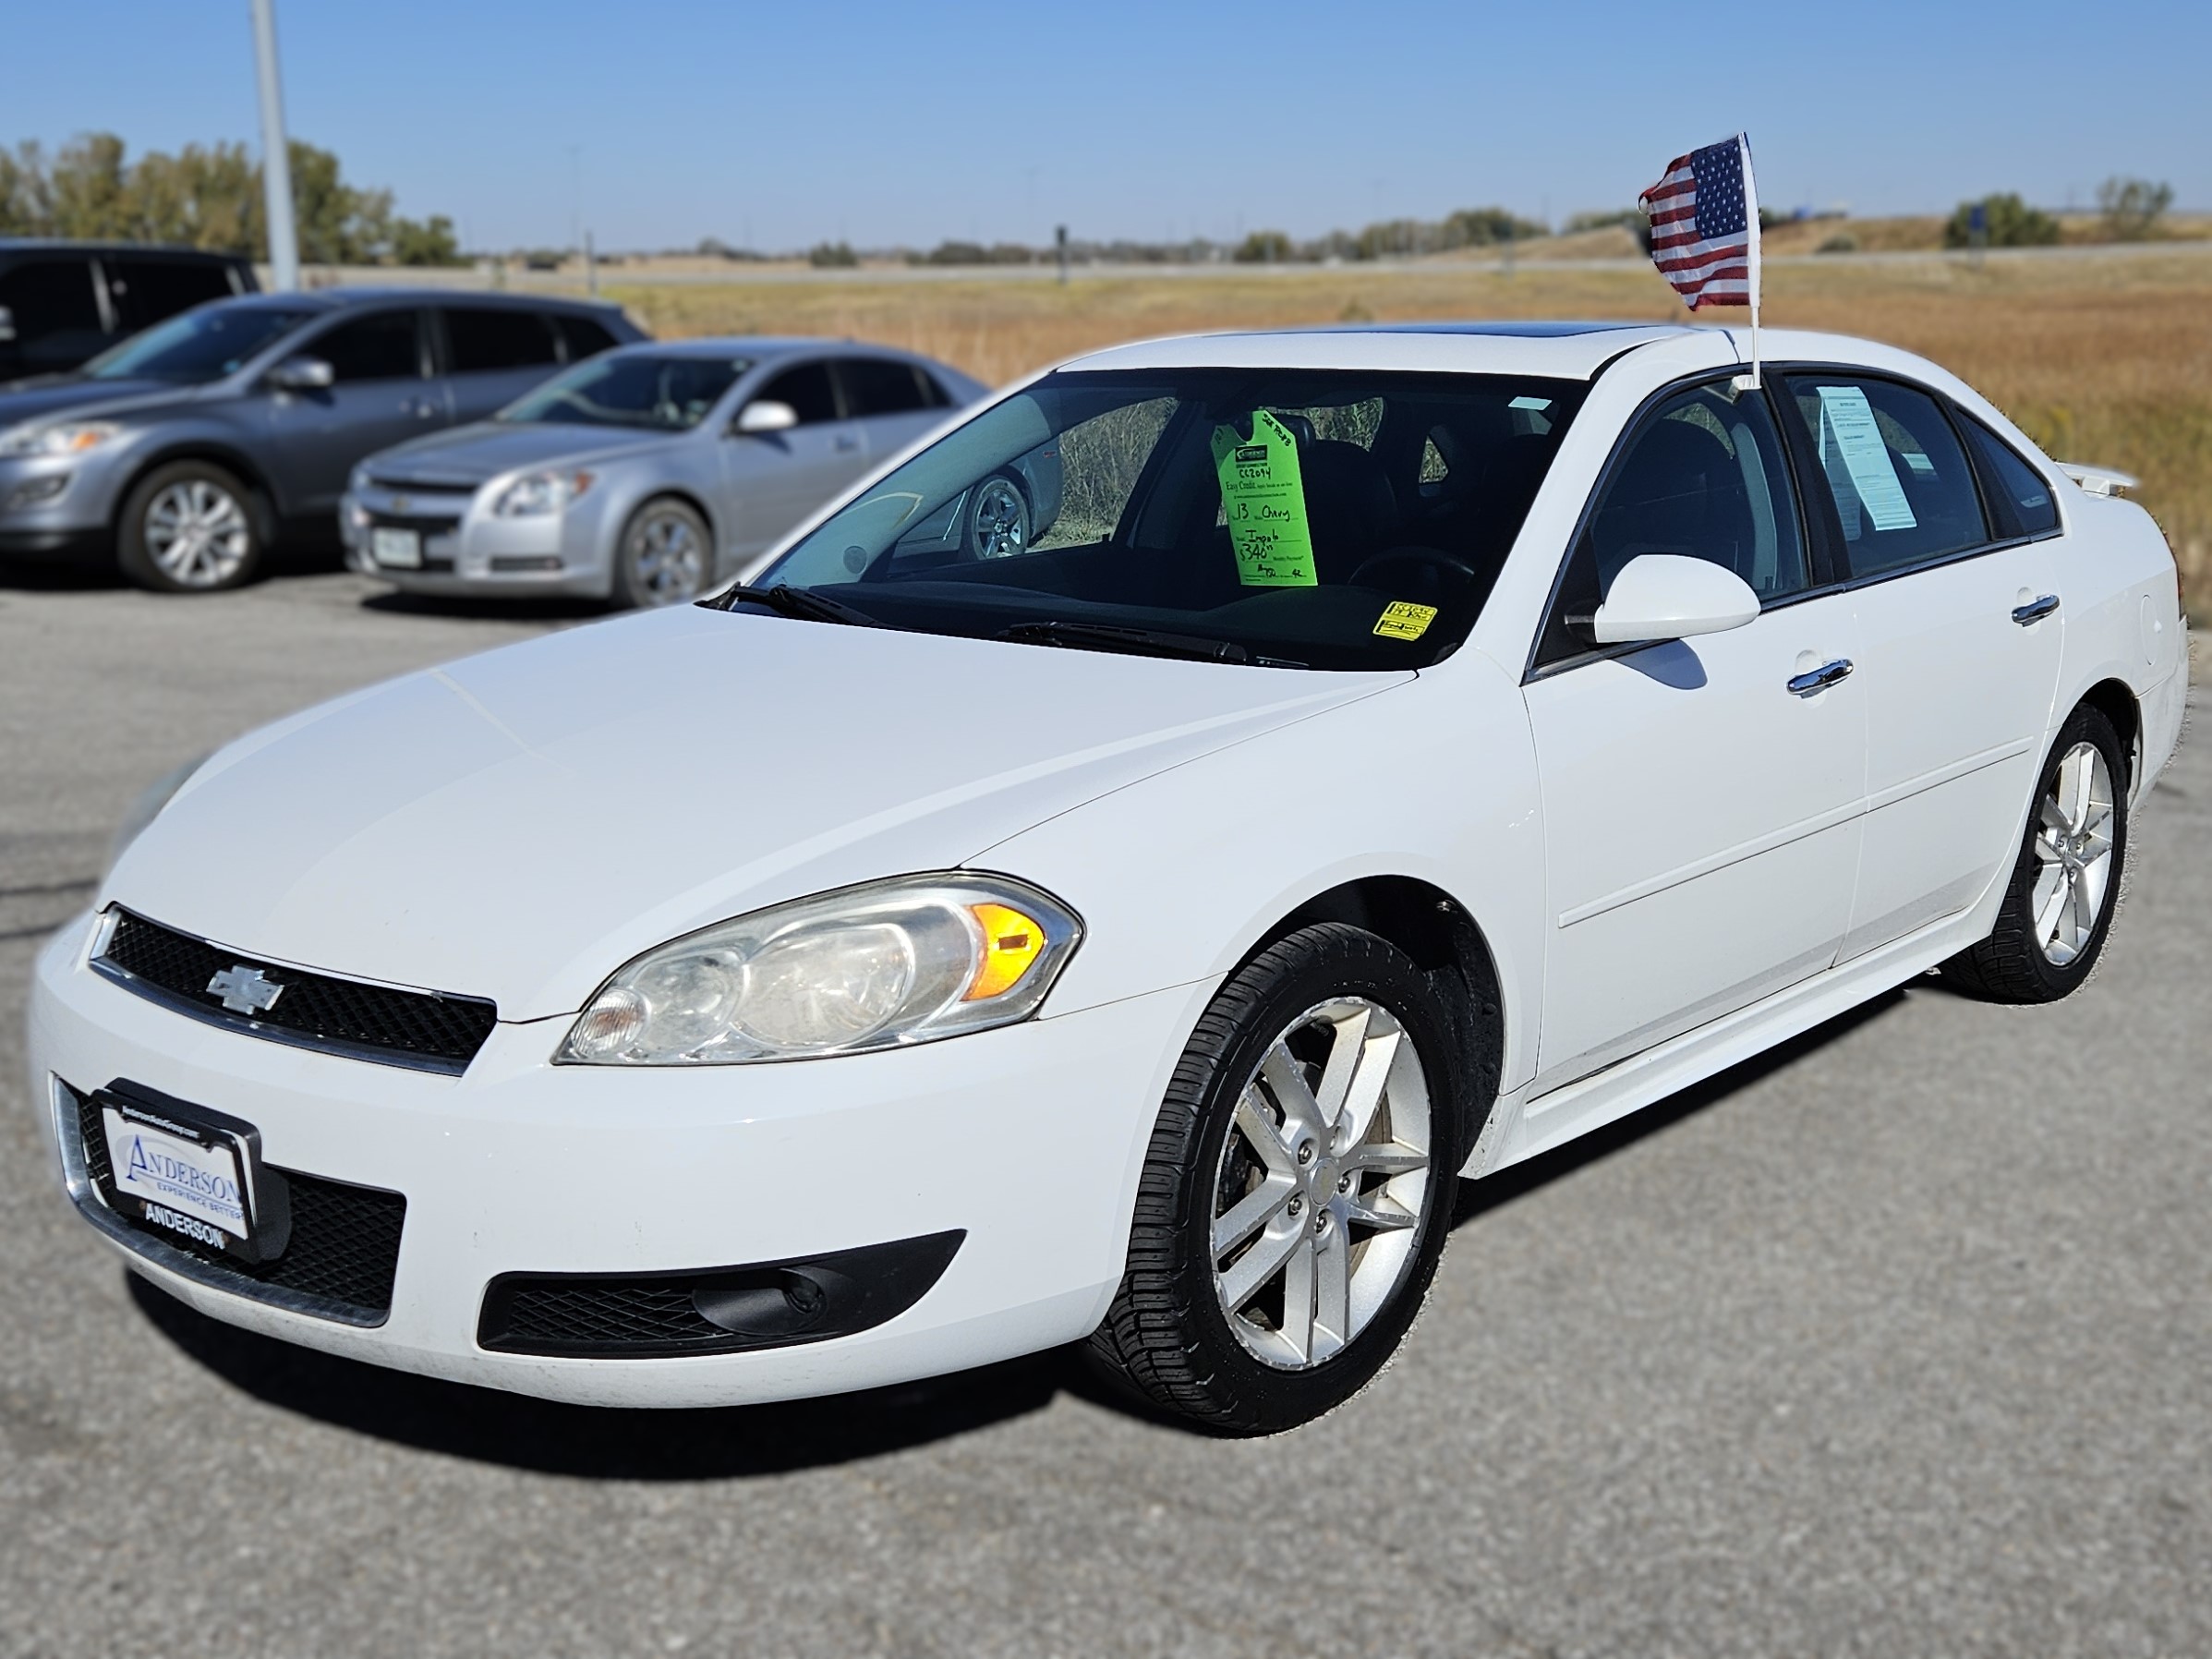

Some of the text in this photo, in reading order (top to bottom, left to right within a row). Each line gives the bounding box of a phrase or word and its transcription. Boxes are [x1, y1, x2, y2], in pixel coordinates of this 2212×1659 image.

[1239, 467, 1272, 479] CC2094
[1238, 503, 1249, 519] 13
[127, 1133, 243, 1204] ANDERSON
[157, 1181, 207, 1208] EXPERIENCE
[146, 1203, 226, 1250] ANDERSON
